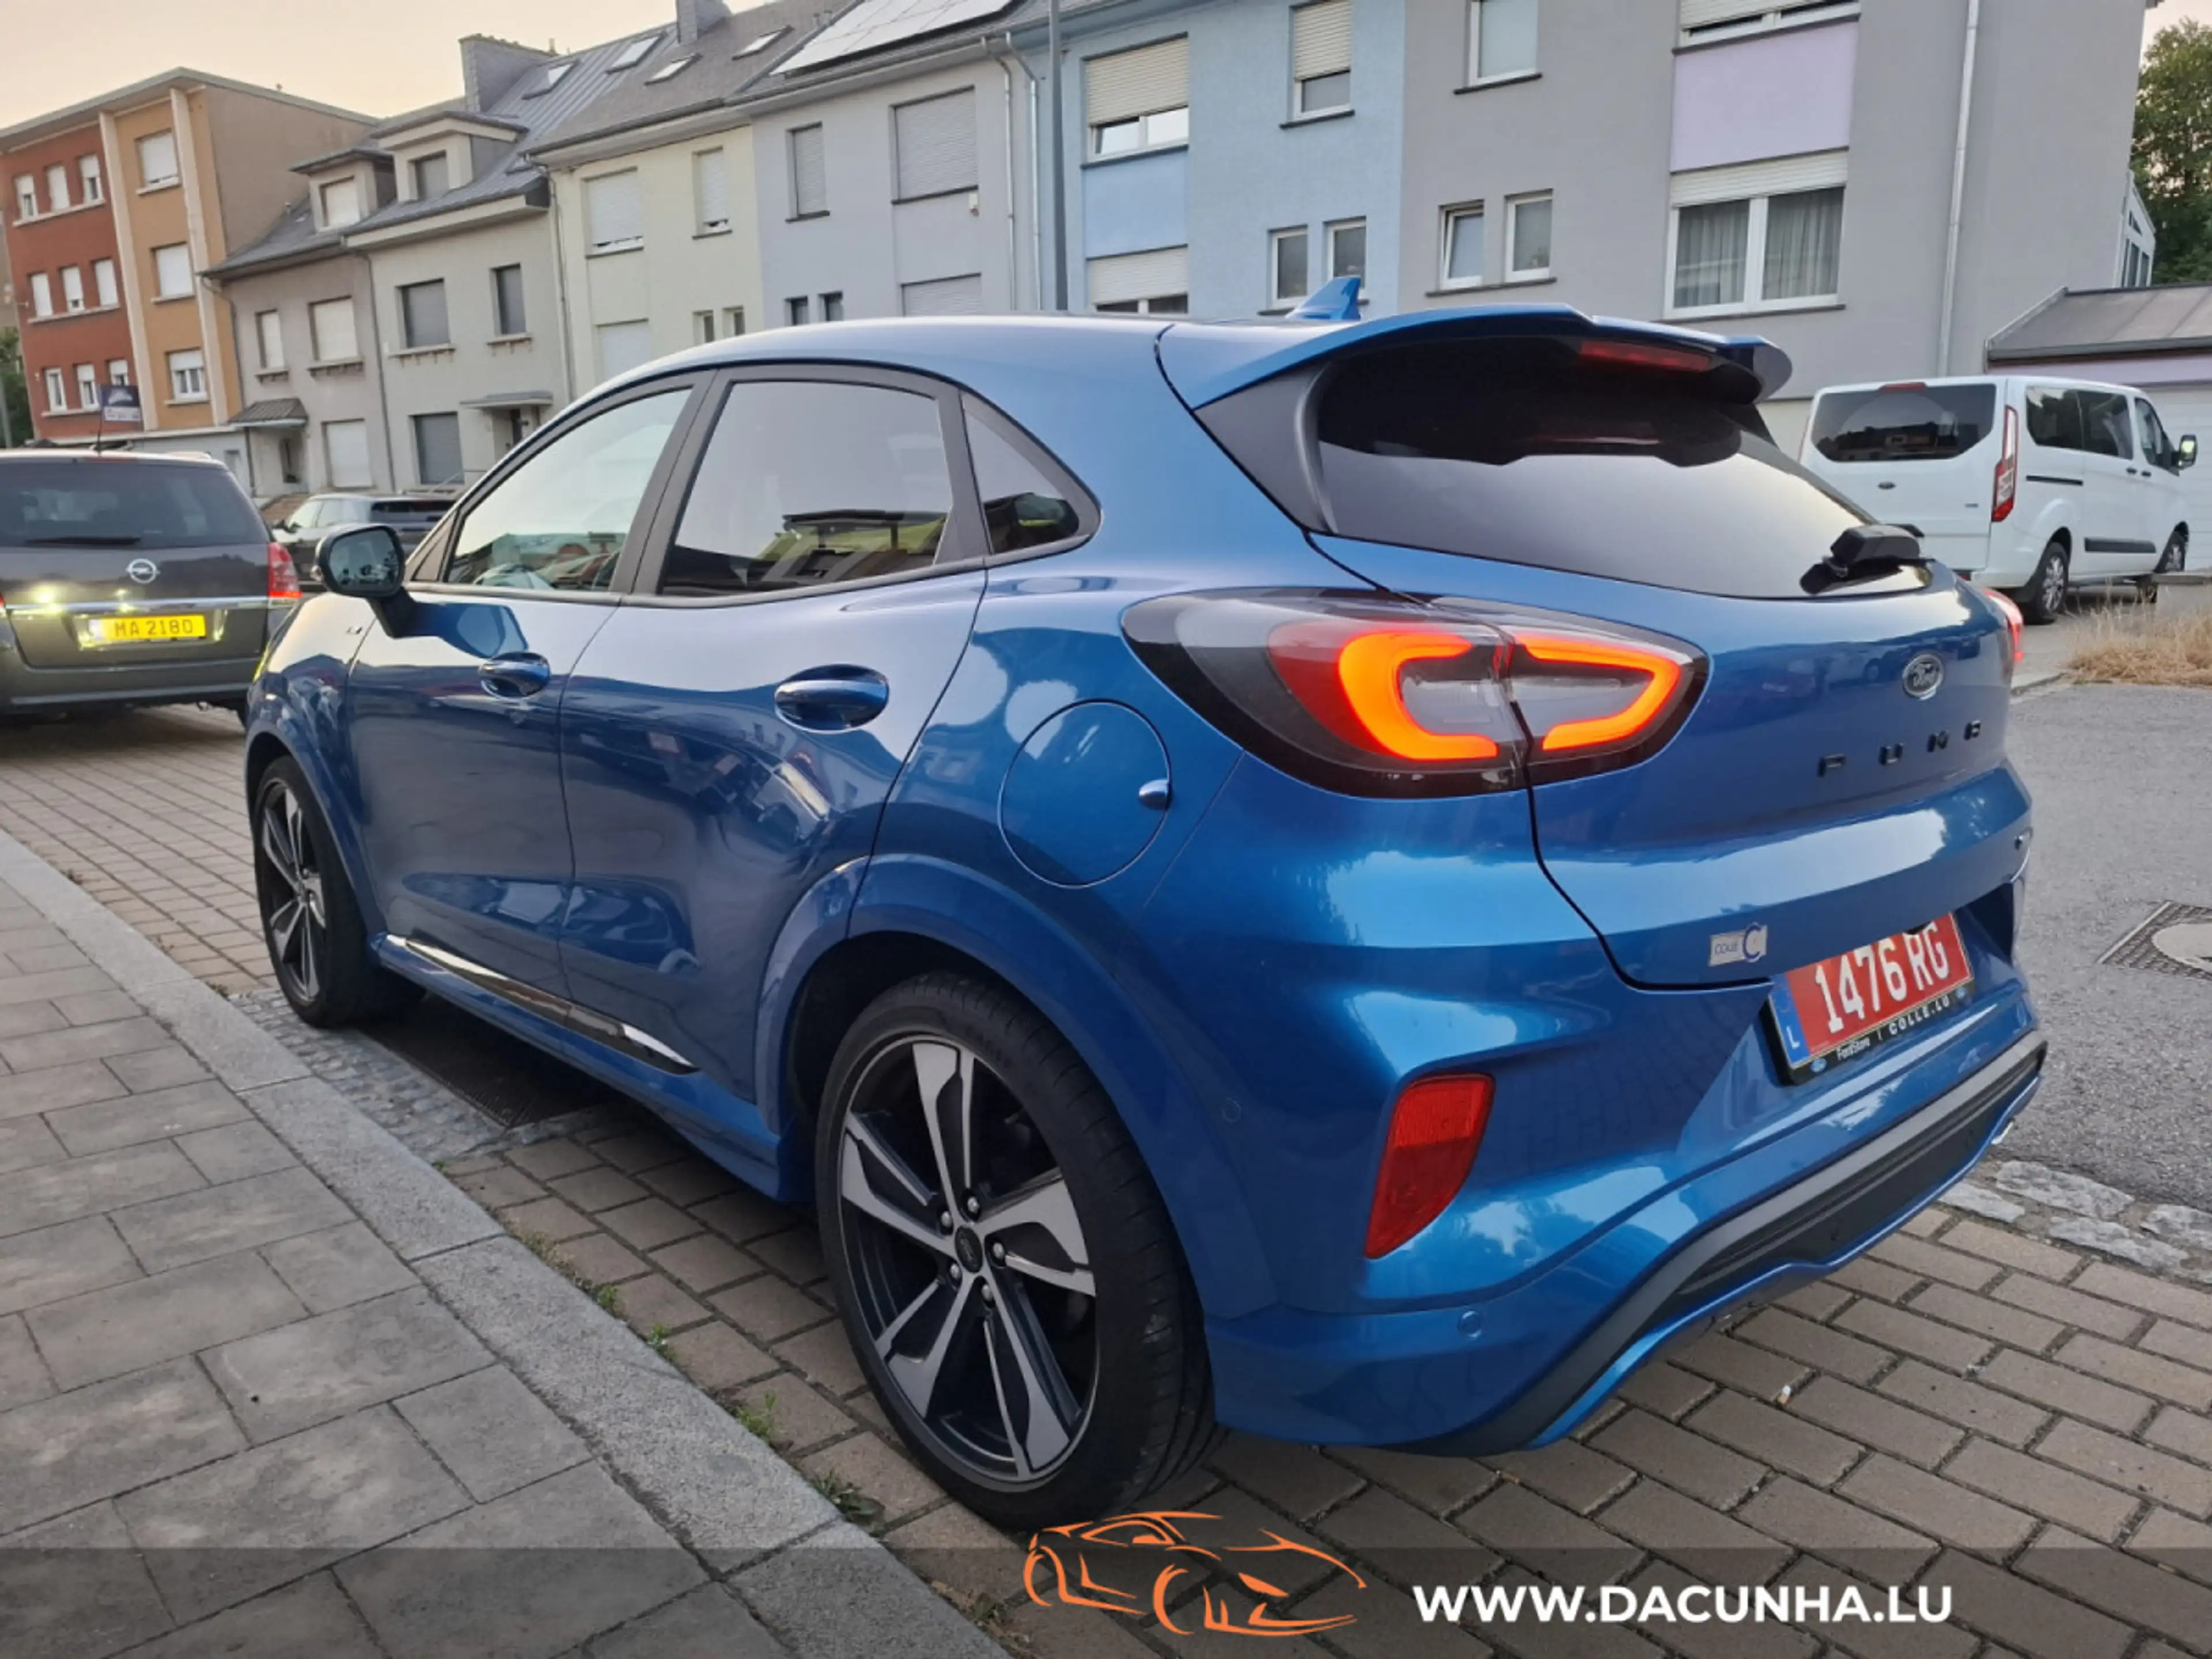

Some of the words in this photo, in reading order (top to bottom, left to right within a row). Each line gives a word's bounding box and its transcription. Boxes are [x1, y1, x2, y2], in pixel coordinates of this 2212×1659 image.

[114, 620, 139, 637] MA
[1815, 937, 1907, 1033] 1476
[1902, 921, 1949, 991] RG
[1786, 1026, 1801, 1049] L
